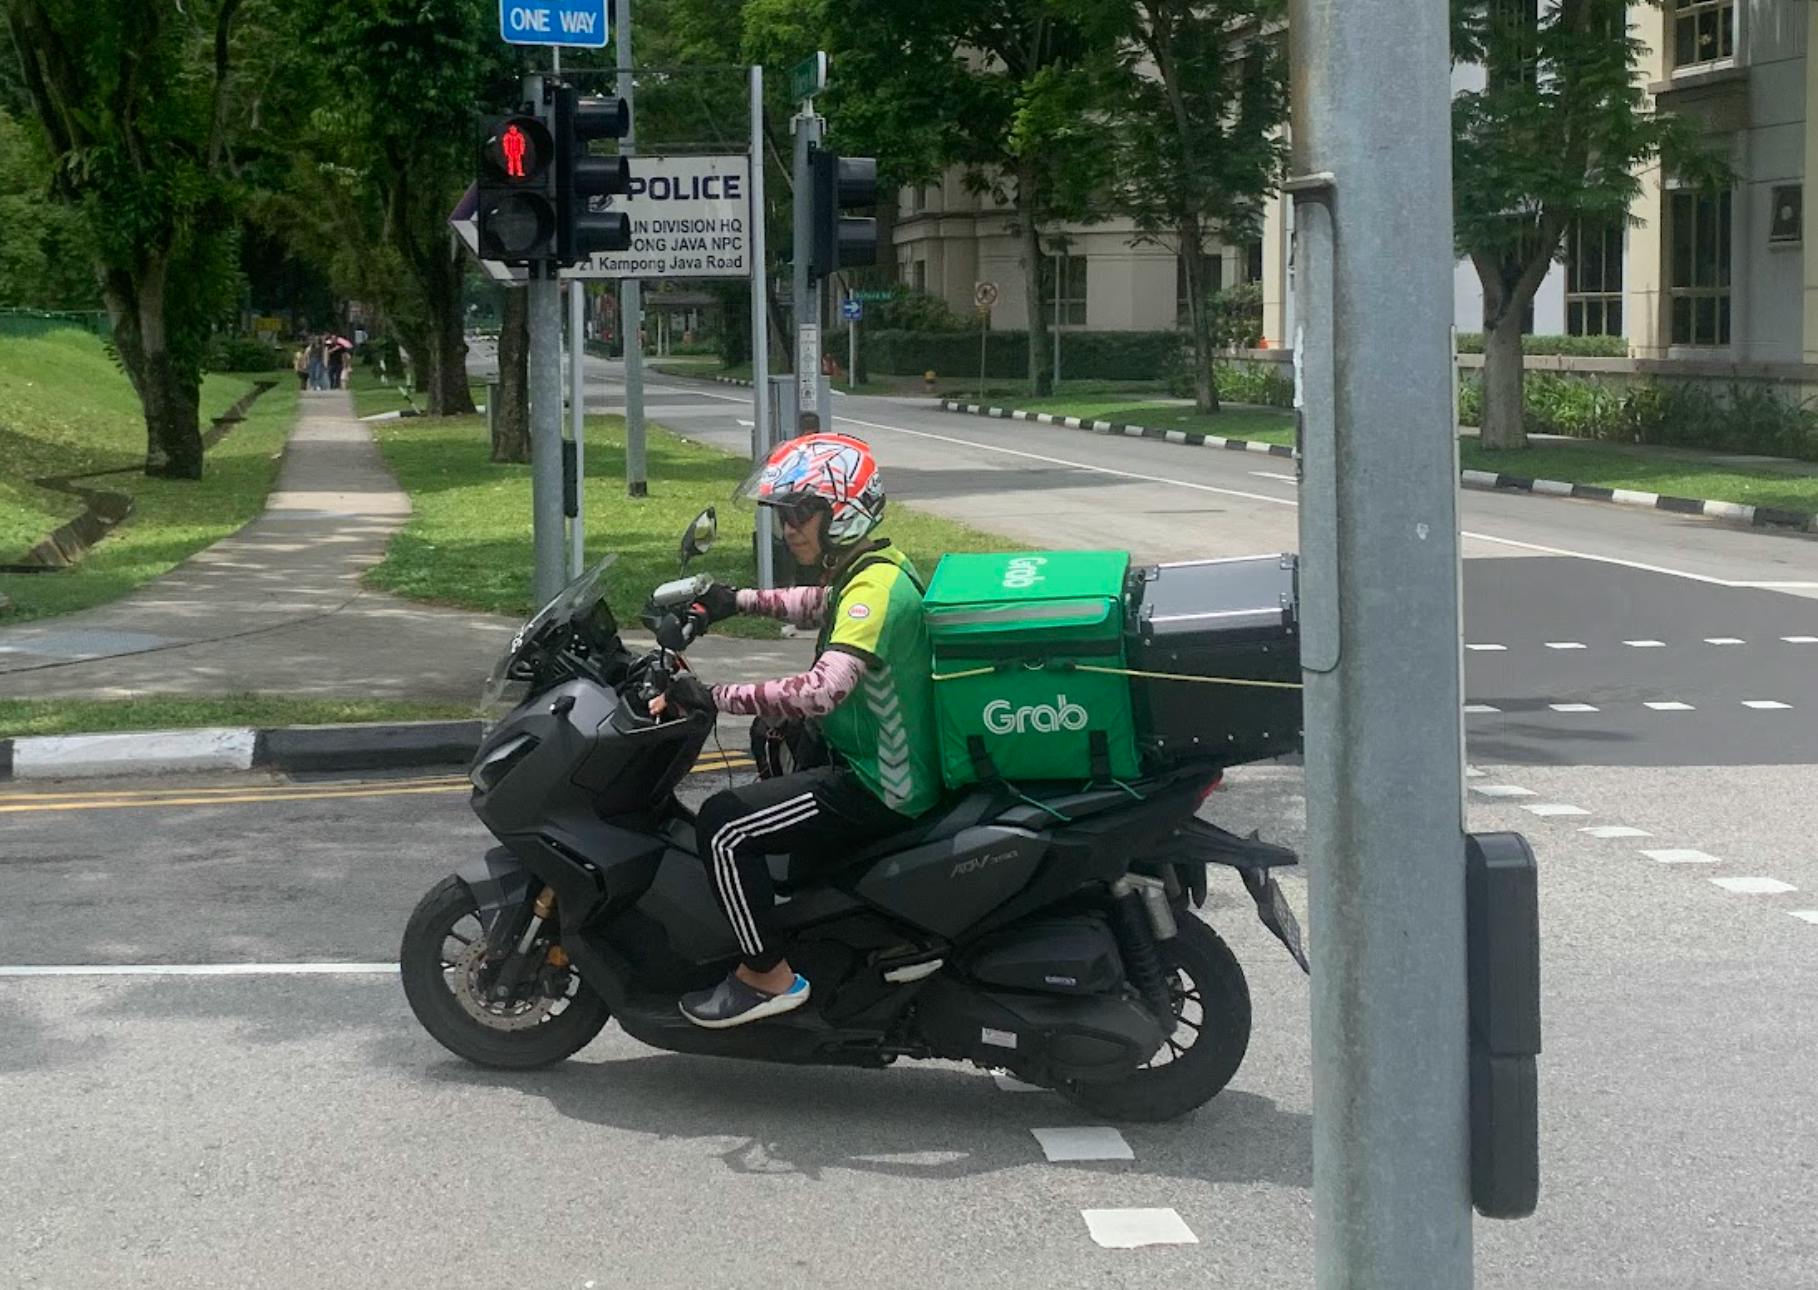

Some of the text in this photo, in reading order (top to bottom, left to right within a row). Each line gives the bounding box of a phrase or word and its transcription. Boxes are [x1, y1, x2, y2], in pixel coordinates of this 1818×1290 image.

[510, 7, 597, 34] ONE WAY
[626, 175, 742, 201] POLICE
[653, 219, 716, 234] DIVISION
[721, 219, 742, 234] HQ
[671, 238, 708, 252] JAVA
[712, 237, 742, 251] NPC
[599, 256, 665, 273] Kampong
[670, 256, 702, 270] Java
[706, 255, 742, 269] Road
[1003, 557, 1047, 588] Grab
[983, 694, 1088, 735] Grab
